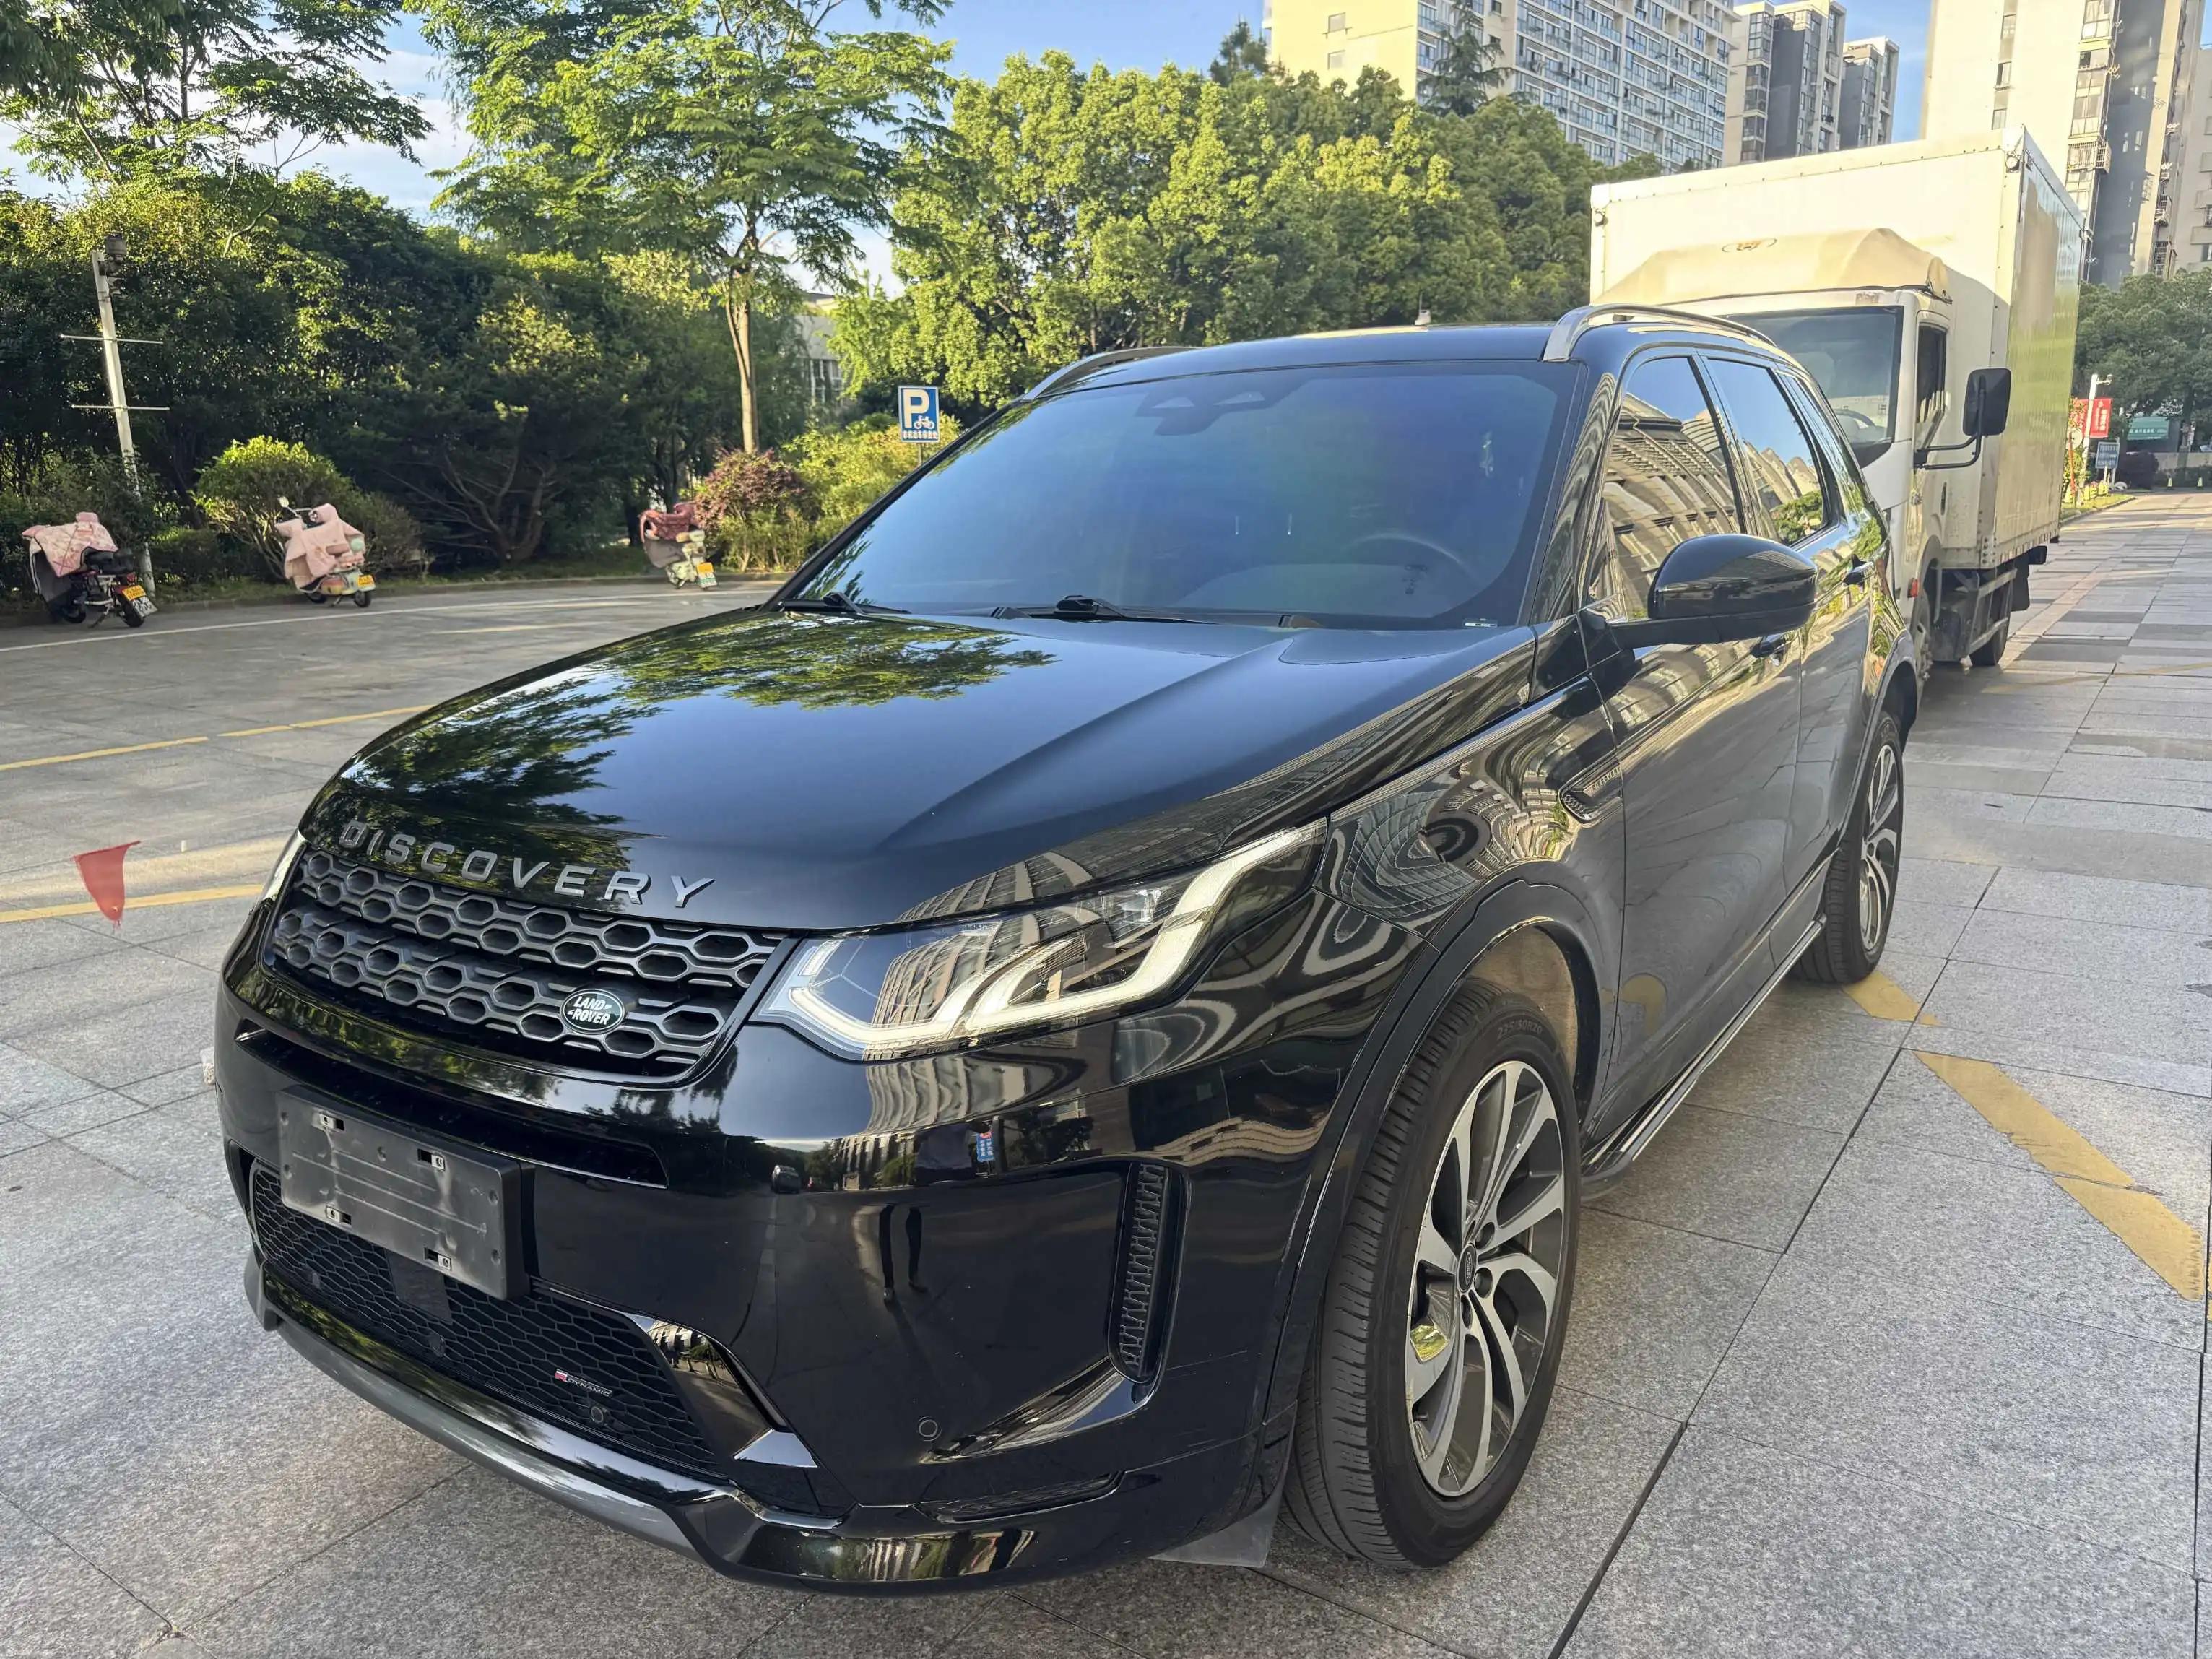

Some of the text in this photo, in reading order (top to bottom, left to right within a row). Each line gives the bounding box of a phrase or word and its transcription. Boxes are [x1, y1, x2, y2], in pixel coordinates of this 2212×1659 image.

[903, 389, 929, 428] P
[340, 820, 715, 908] DISCOVERY
[573, 995, 606, 1010] LAND
[571, 1008, 611, 1025] ROVER
[568, 1379, 610, 1397] DYNAMIC
